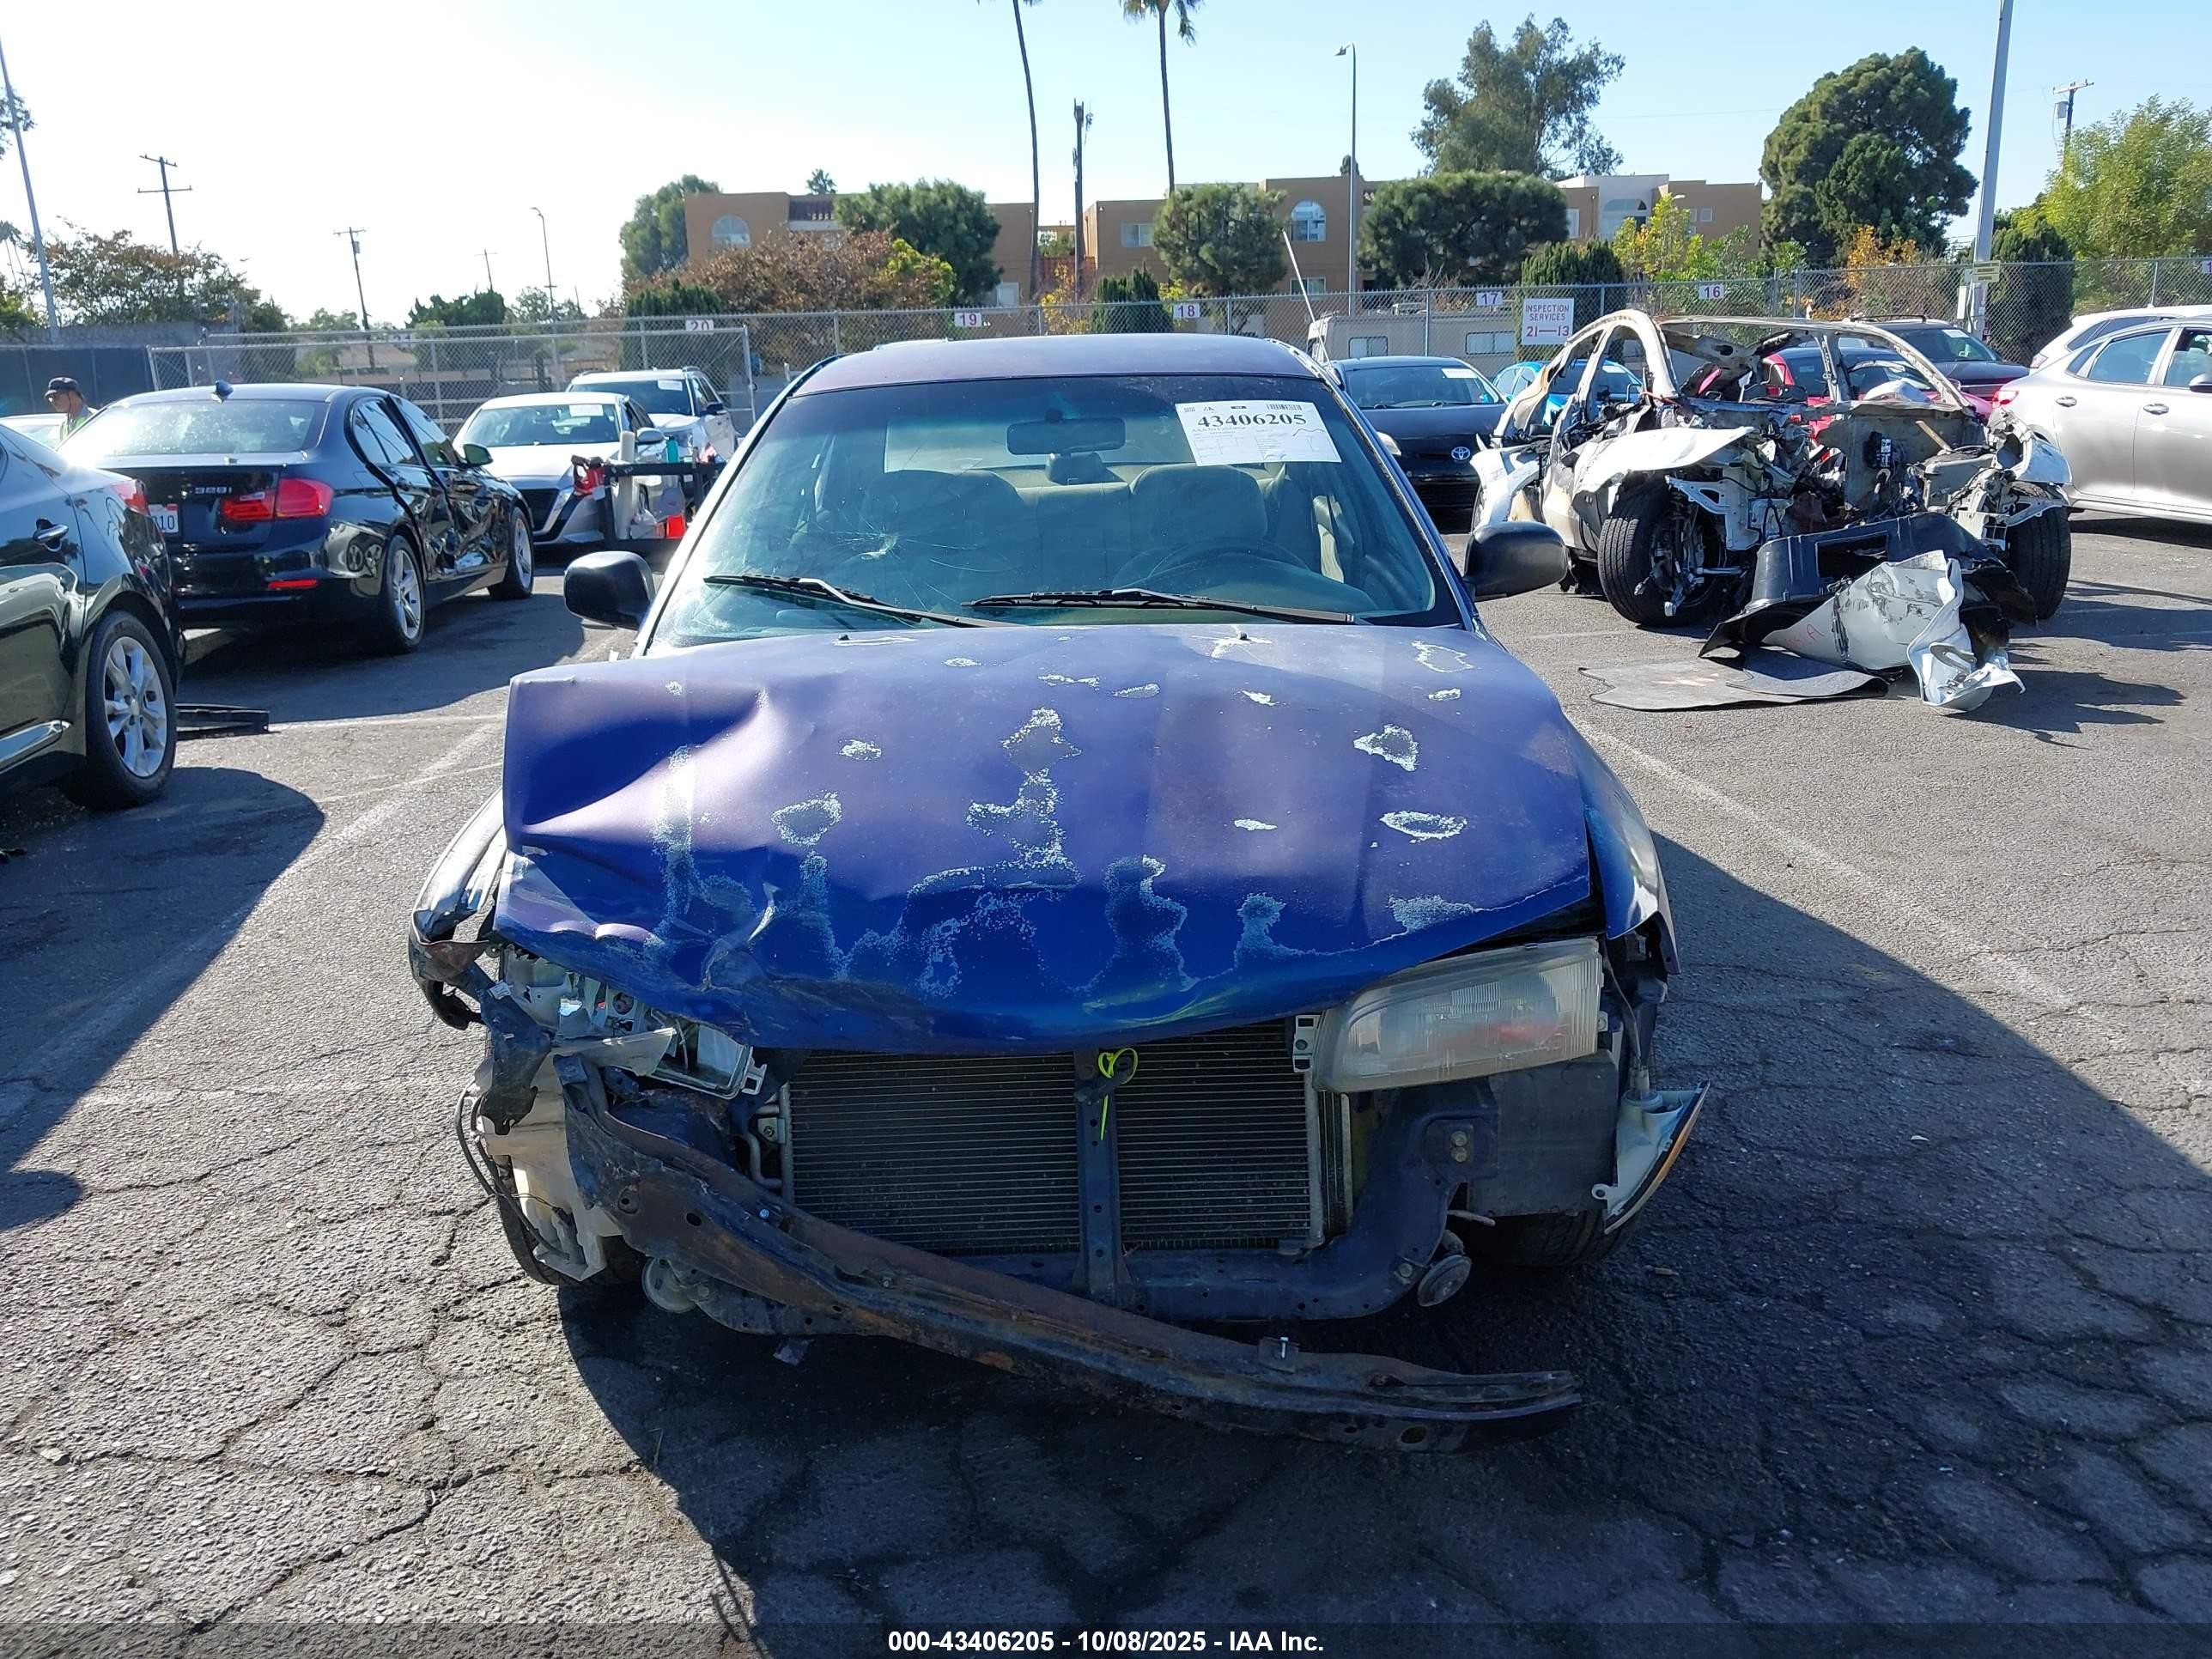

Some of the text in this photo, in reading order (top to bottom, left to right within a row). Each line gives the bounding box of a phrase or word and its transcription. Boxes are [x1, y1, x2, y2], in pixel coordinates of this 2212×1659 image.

[1704, 285, 1721, 298] 16
[1481, 292, 1498, 305] 17
[1177, 305, 1195, 318] 18
[1525, 304, 1570, 313] INSPECTION
[959, 313, 977, 326] 19
[1529, 313, 1566, 321] SERVICES
[1197, 413, 1307, 428] 43406205
